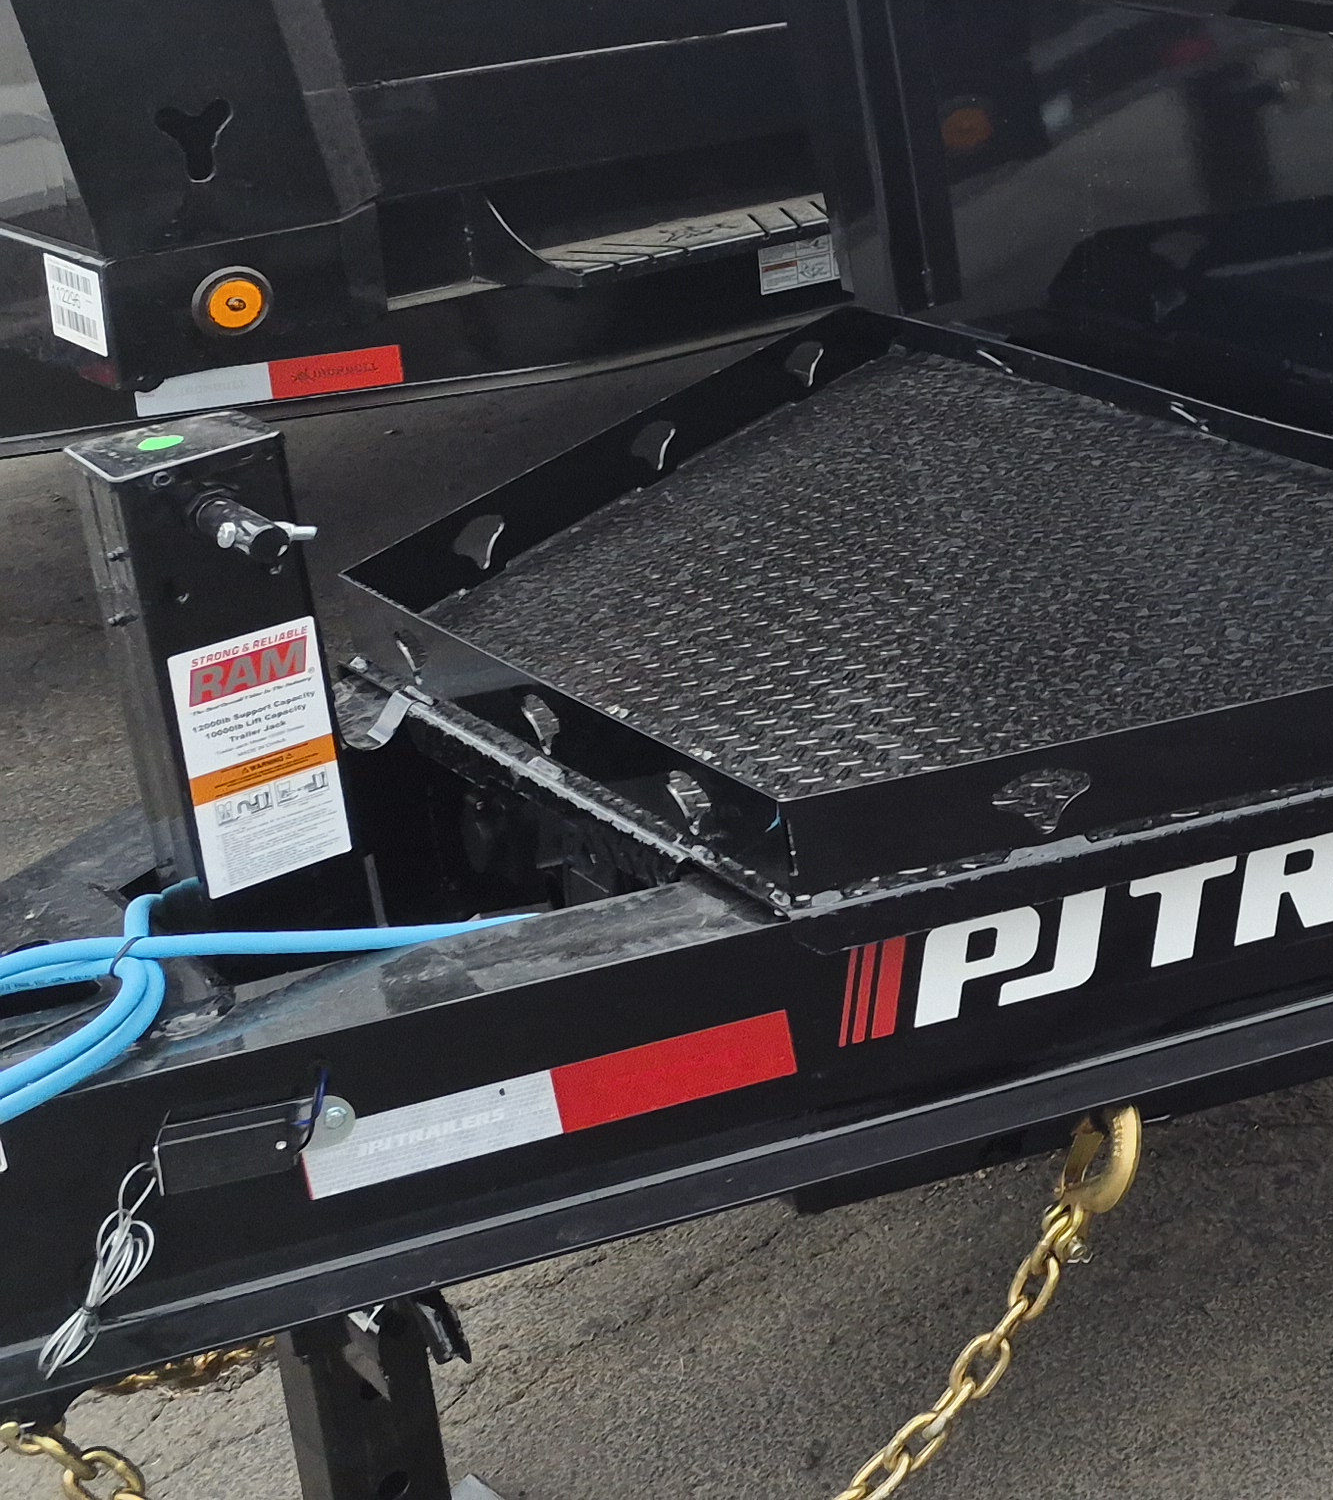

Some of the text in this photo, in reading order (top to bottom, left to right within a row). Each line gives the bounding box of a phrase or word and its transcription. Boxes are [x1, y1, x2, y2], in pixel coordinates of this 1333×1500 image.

[190, 624, 308, 667] STRONG & RELIABLE
[194, 641, 304, 703] RAM
[192, 689, 315, 733] 12000lb Support Capacity
[205, 702, 306, 739] 10000lb Lift Capacity
[229, 719, 286, 742] Trailer Jack
[249, 755, 284, 771] WARNING
[913, 886, 1106, 1028] PJ
